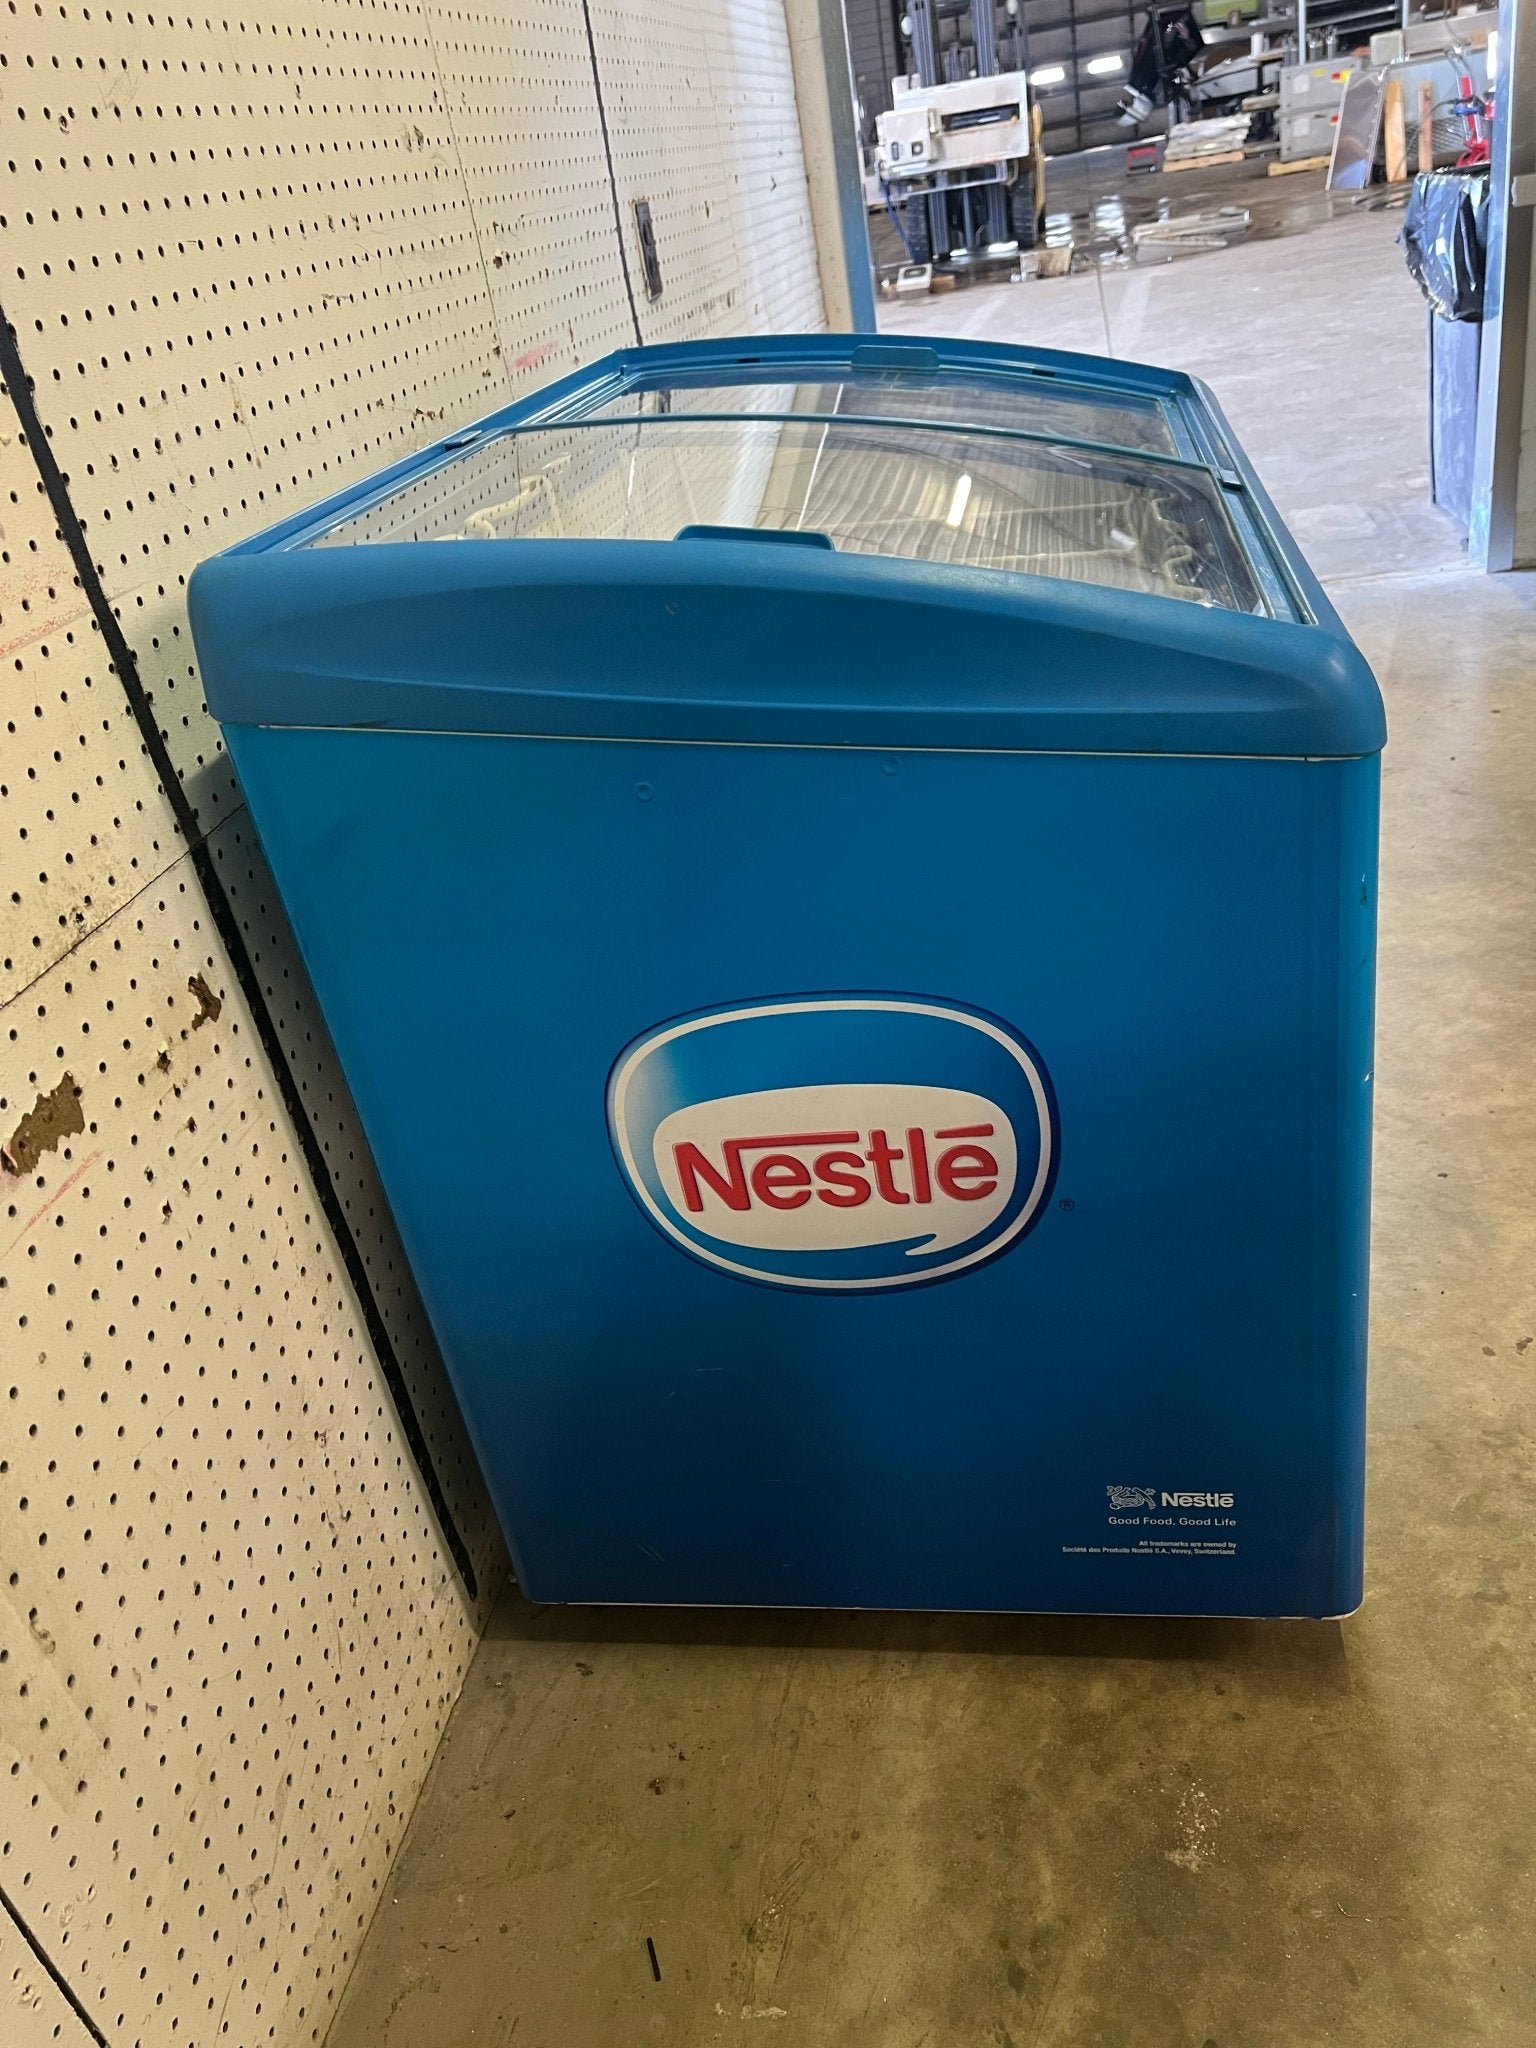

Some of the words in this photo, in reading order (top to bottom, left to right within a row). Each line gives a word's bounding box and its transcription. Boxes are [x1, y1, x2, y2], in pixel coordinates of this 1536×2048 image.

[671, 1123, 999, 1212] Nestlé
[1161, 1492, 1235, 1508] Nestlé
[1108, 1516, 1140, 1525] Good
[1179, 1517, 1211, 1526] Good
[1214, 1518, 1237, 1527] Life
[1102, 1546, 1130, 1554] Produits
[1149, 1540, 1189, 1548] trademarks
[1228, 1541, 1237, 1549] by
